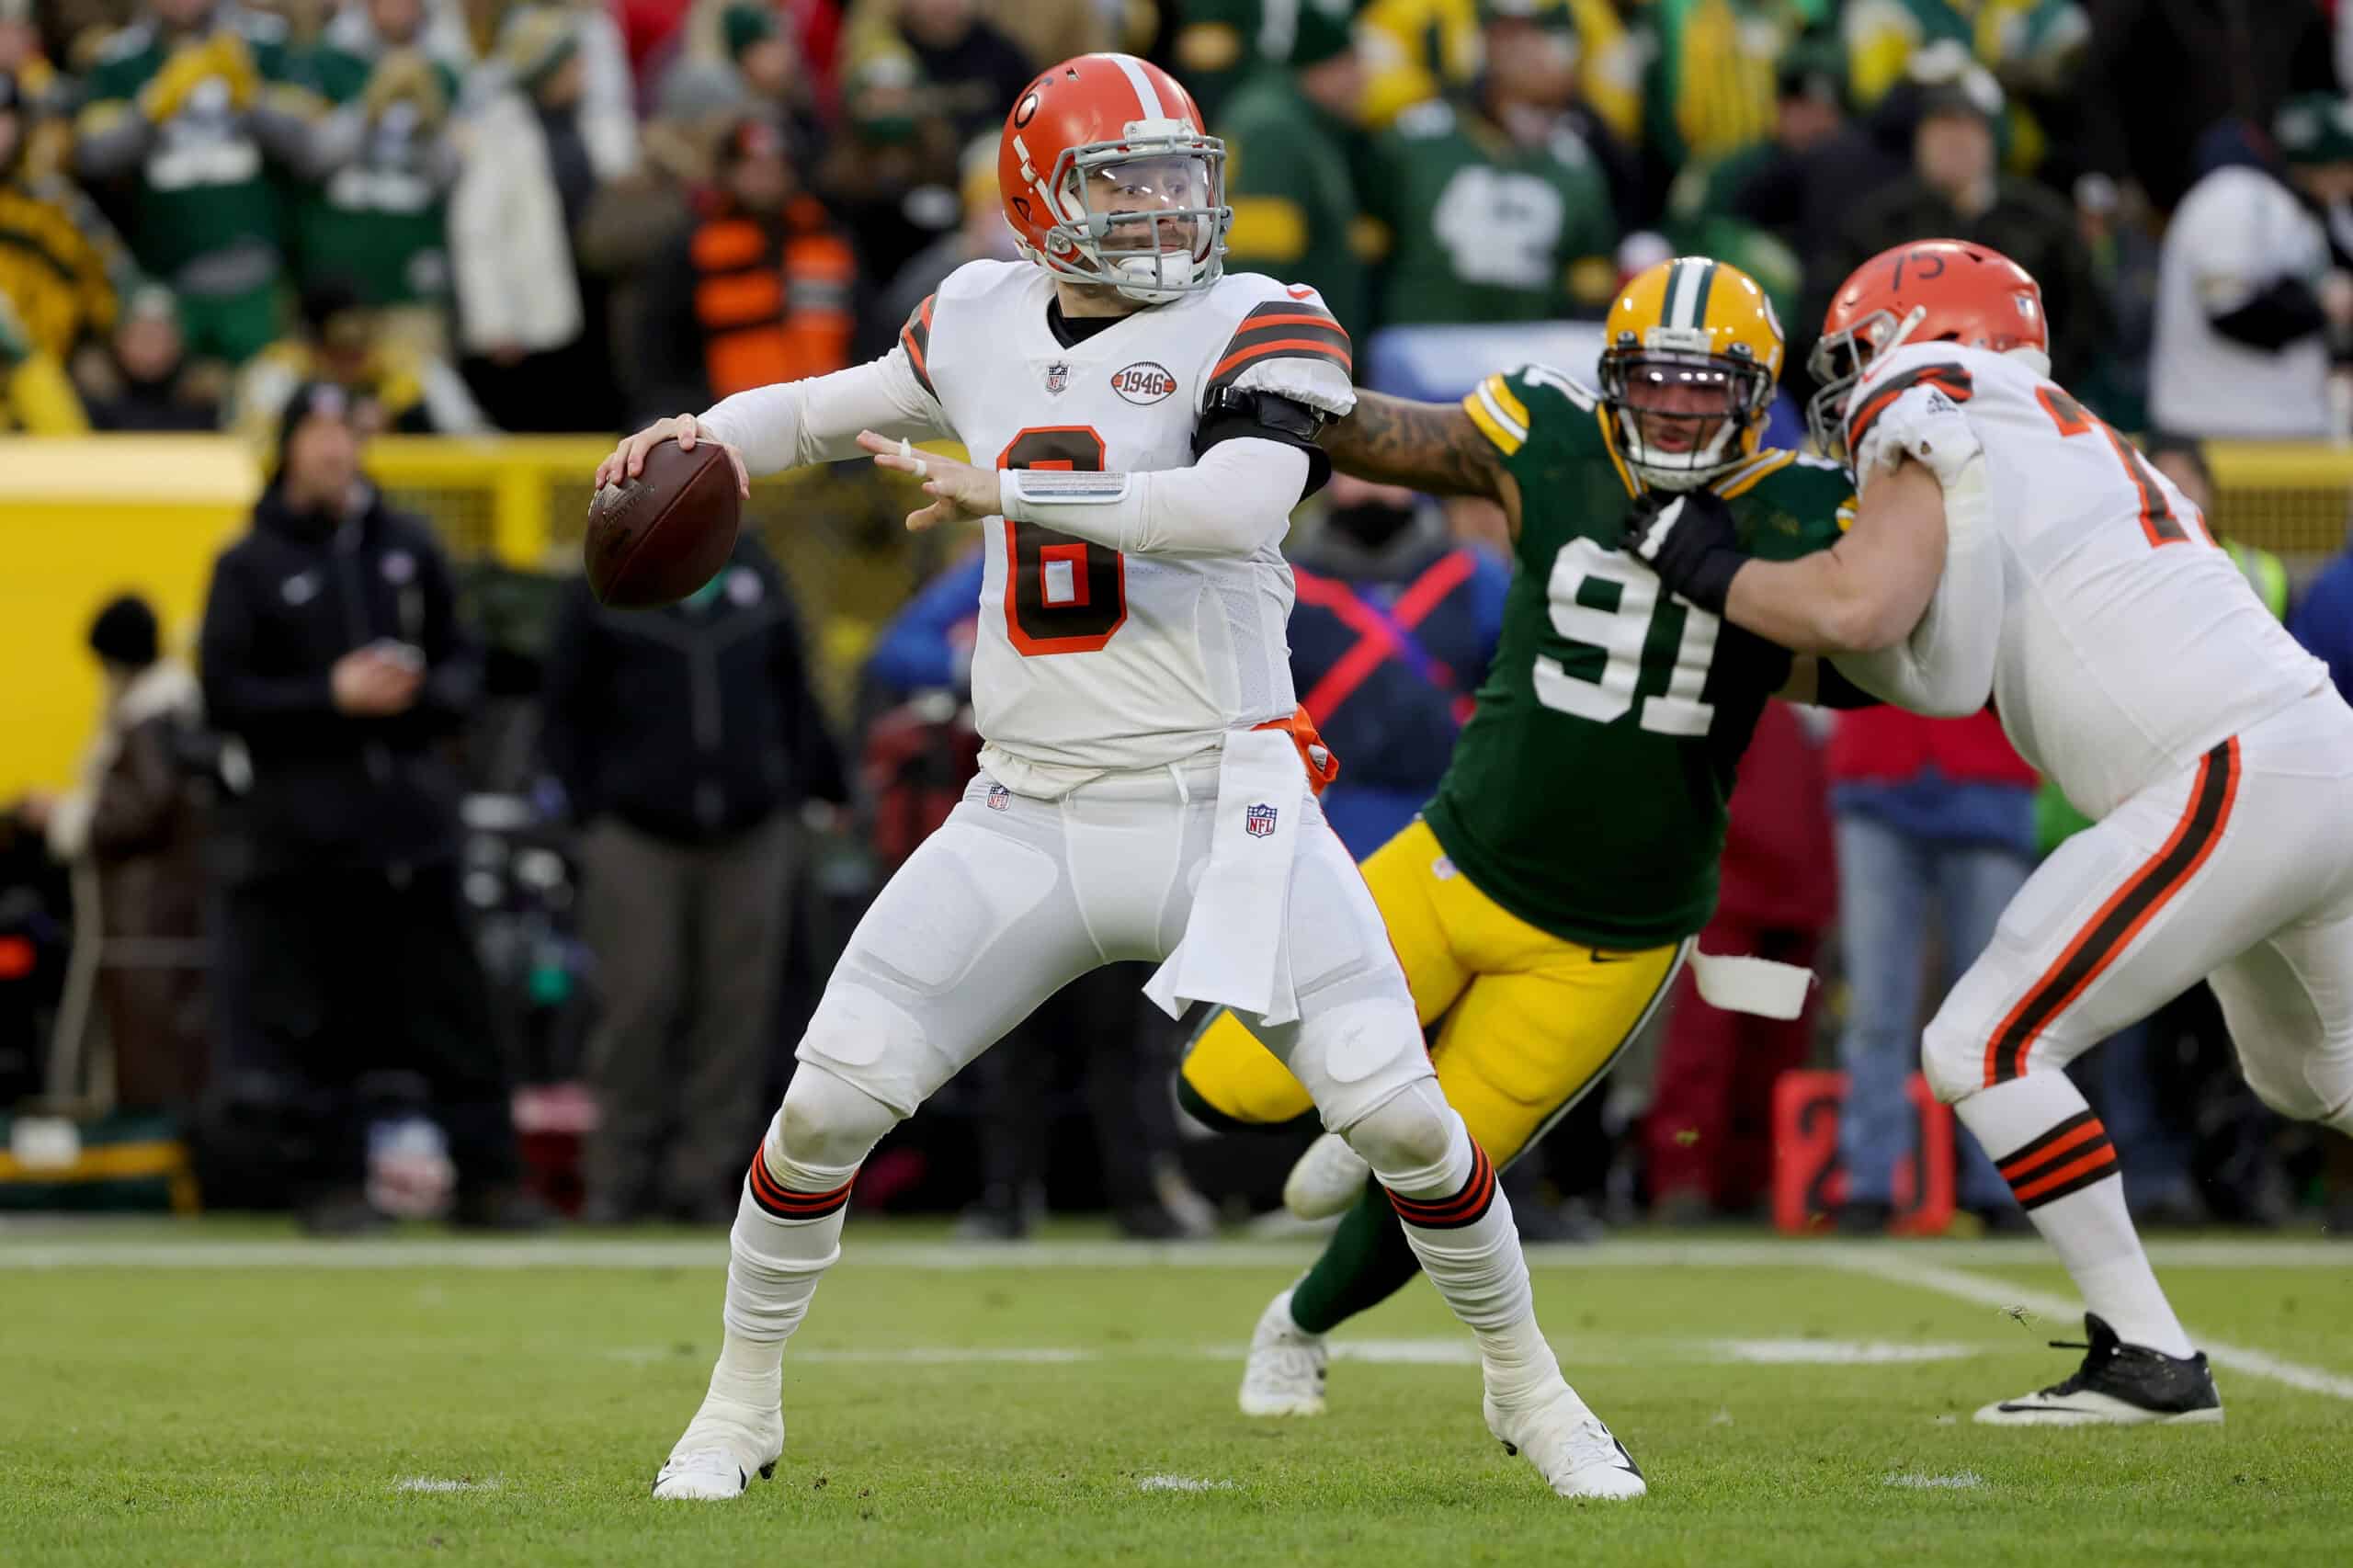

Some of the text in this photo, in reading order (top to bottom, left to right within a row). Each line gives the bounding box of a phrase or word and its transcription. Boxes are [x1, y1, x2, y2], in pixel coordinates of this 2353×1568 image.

[1122, 370, 1164, 396] 1946
[996, 425, 1128, 657] 6
[1532, 535, 1722, 737] 91
[1249, 817, 1274, 834] NFL
